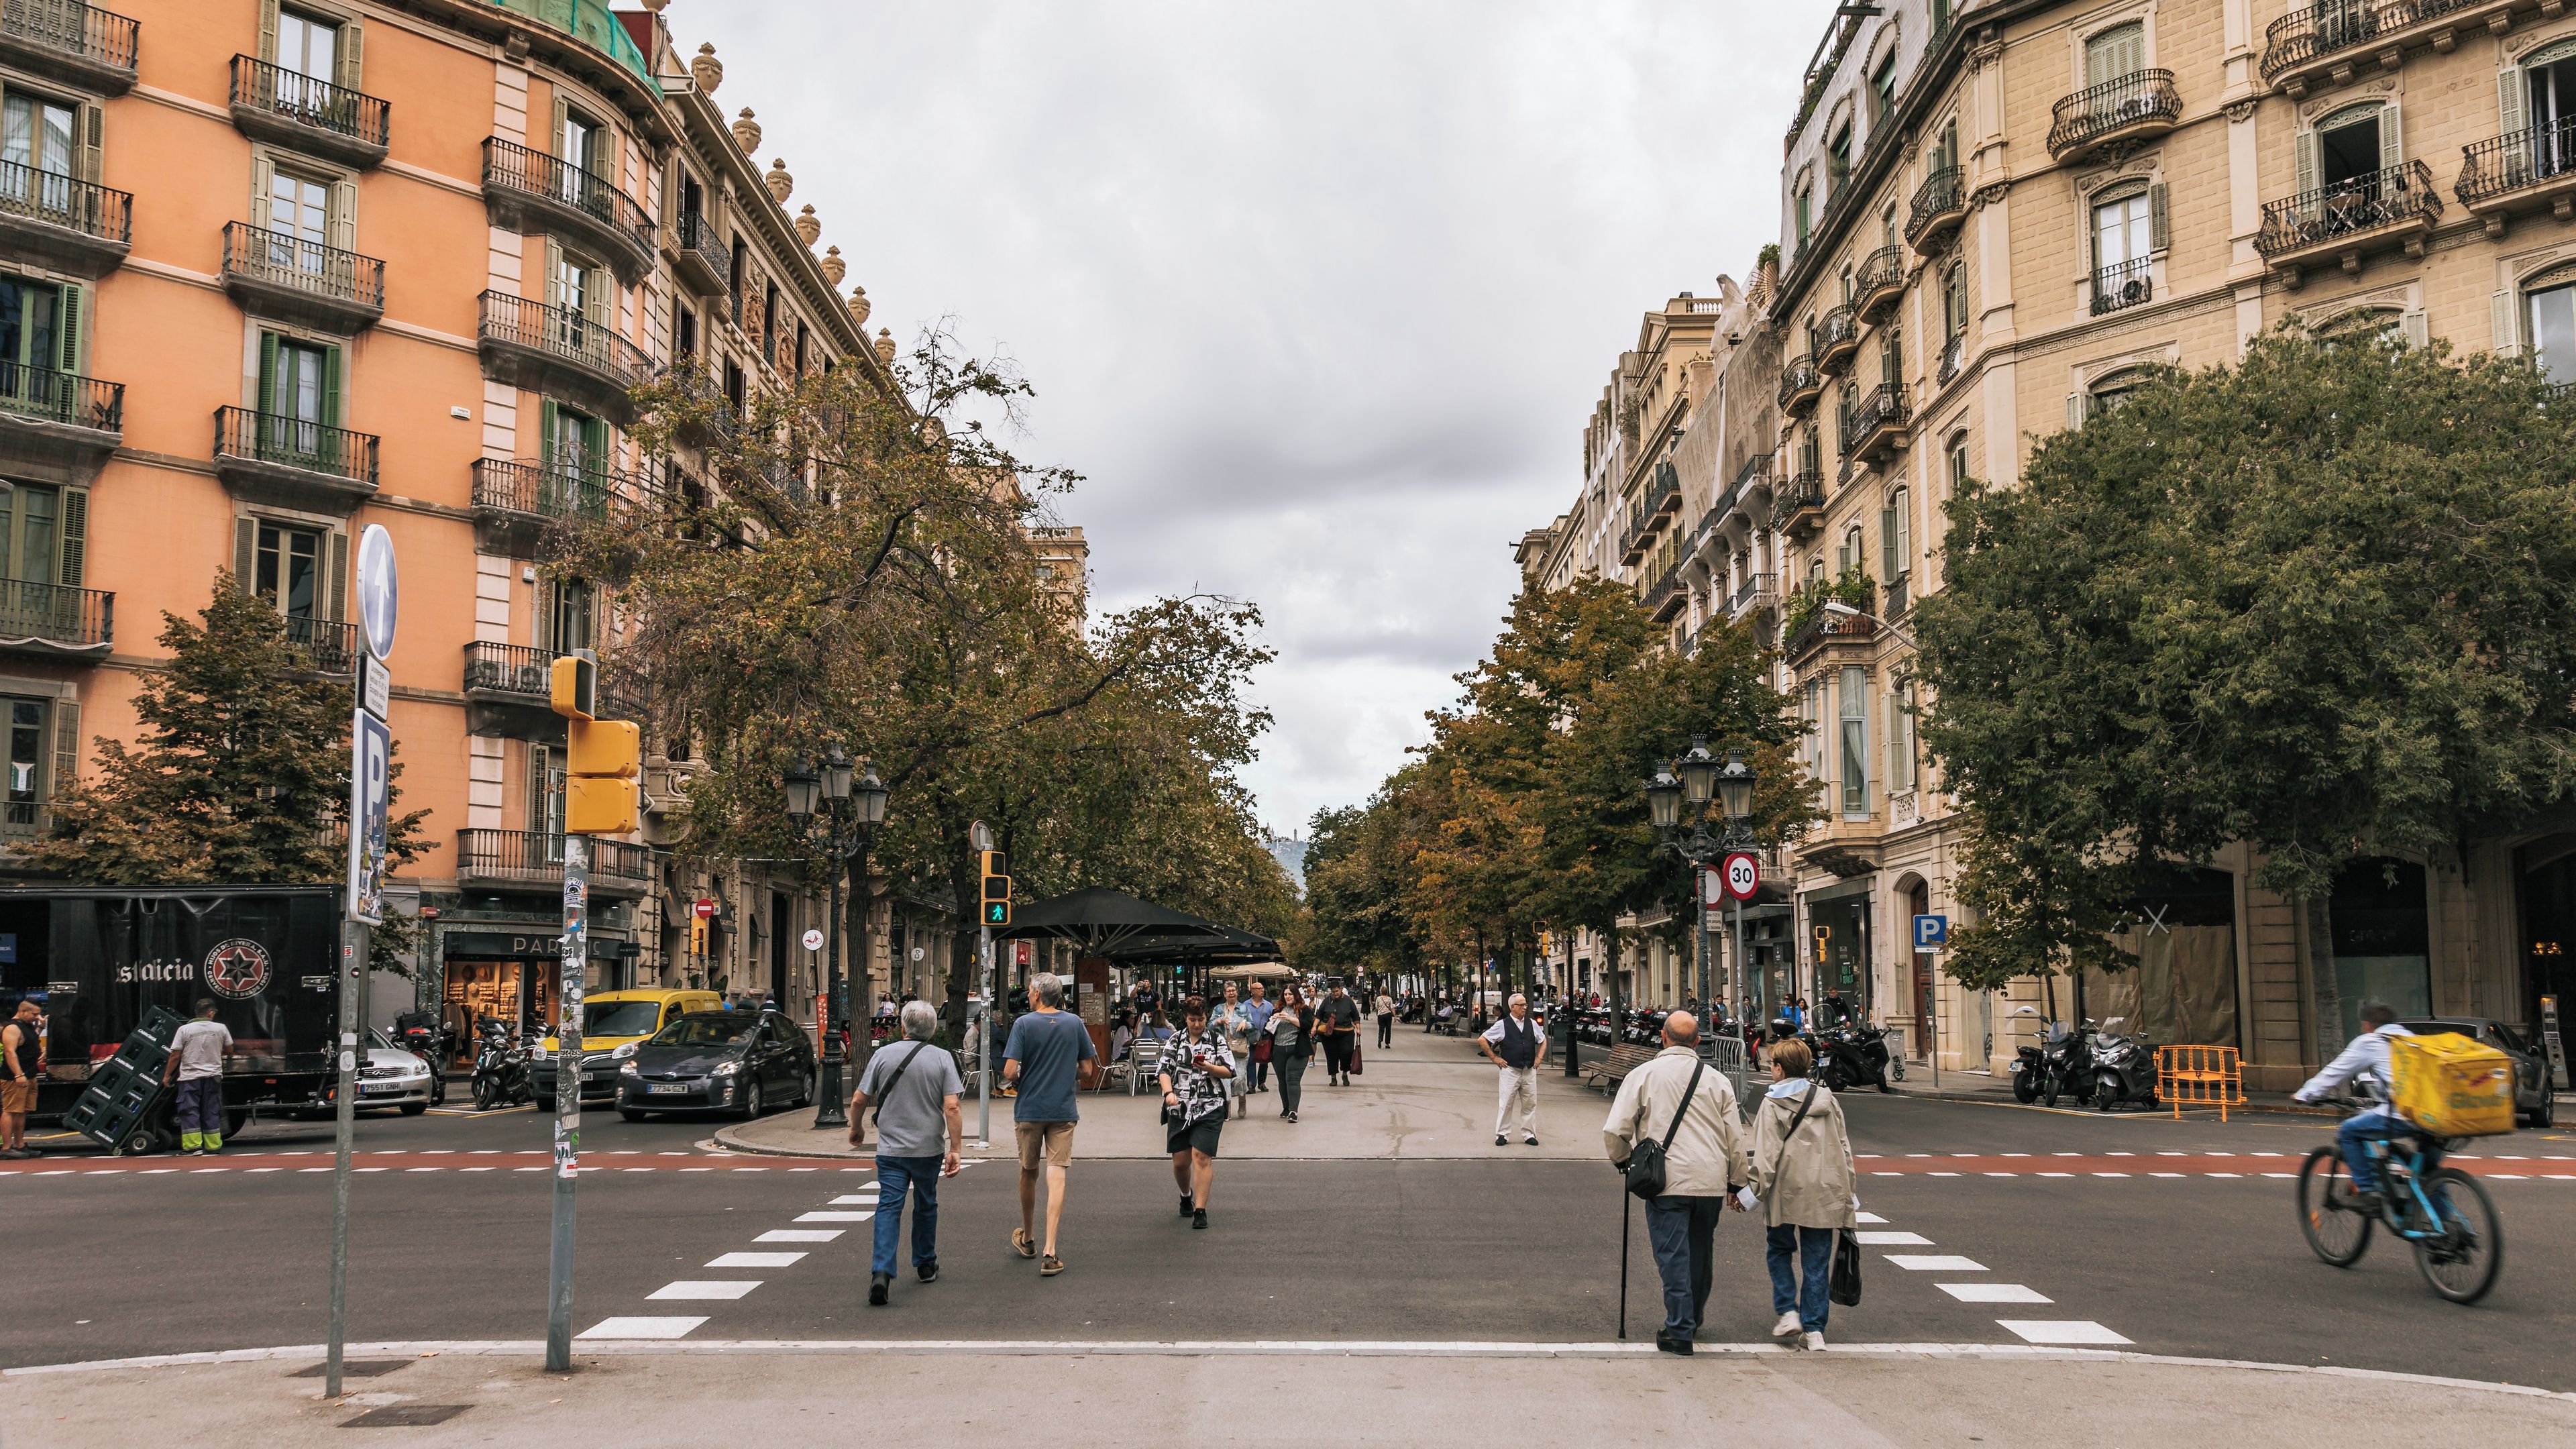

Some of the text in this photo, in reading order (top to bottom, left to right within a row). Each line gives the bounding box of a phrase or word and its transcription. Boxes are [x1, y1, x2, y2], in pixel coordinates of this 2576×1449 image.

[1732, 867, 1752, 883] 30
[1921, 919, 1940, 943] P
[513, 937, 600, 955] PARIS
